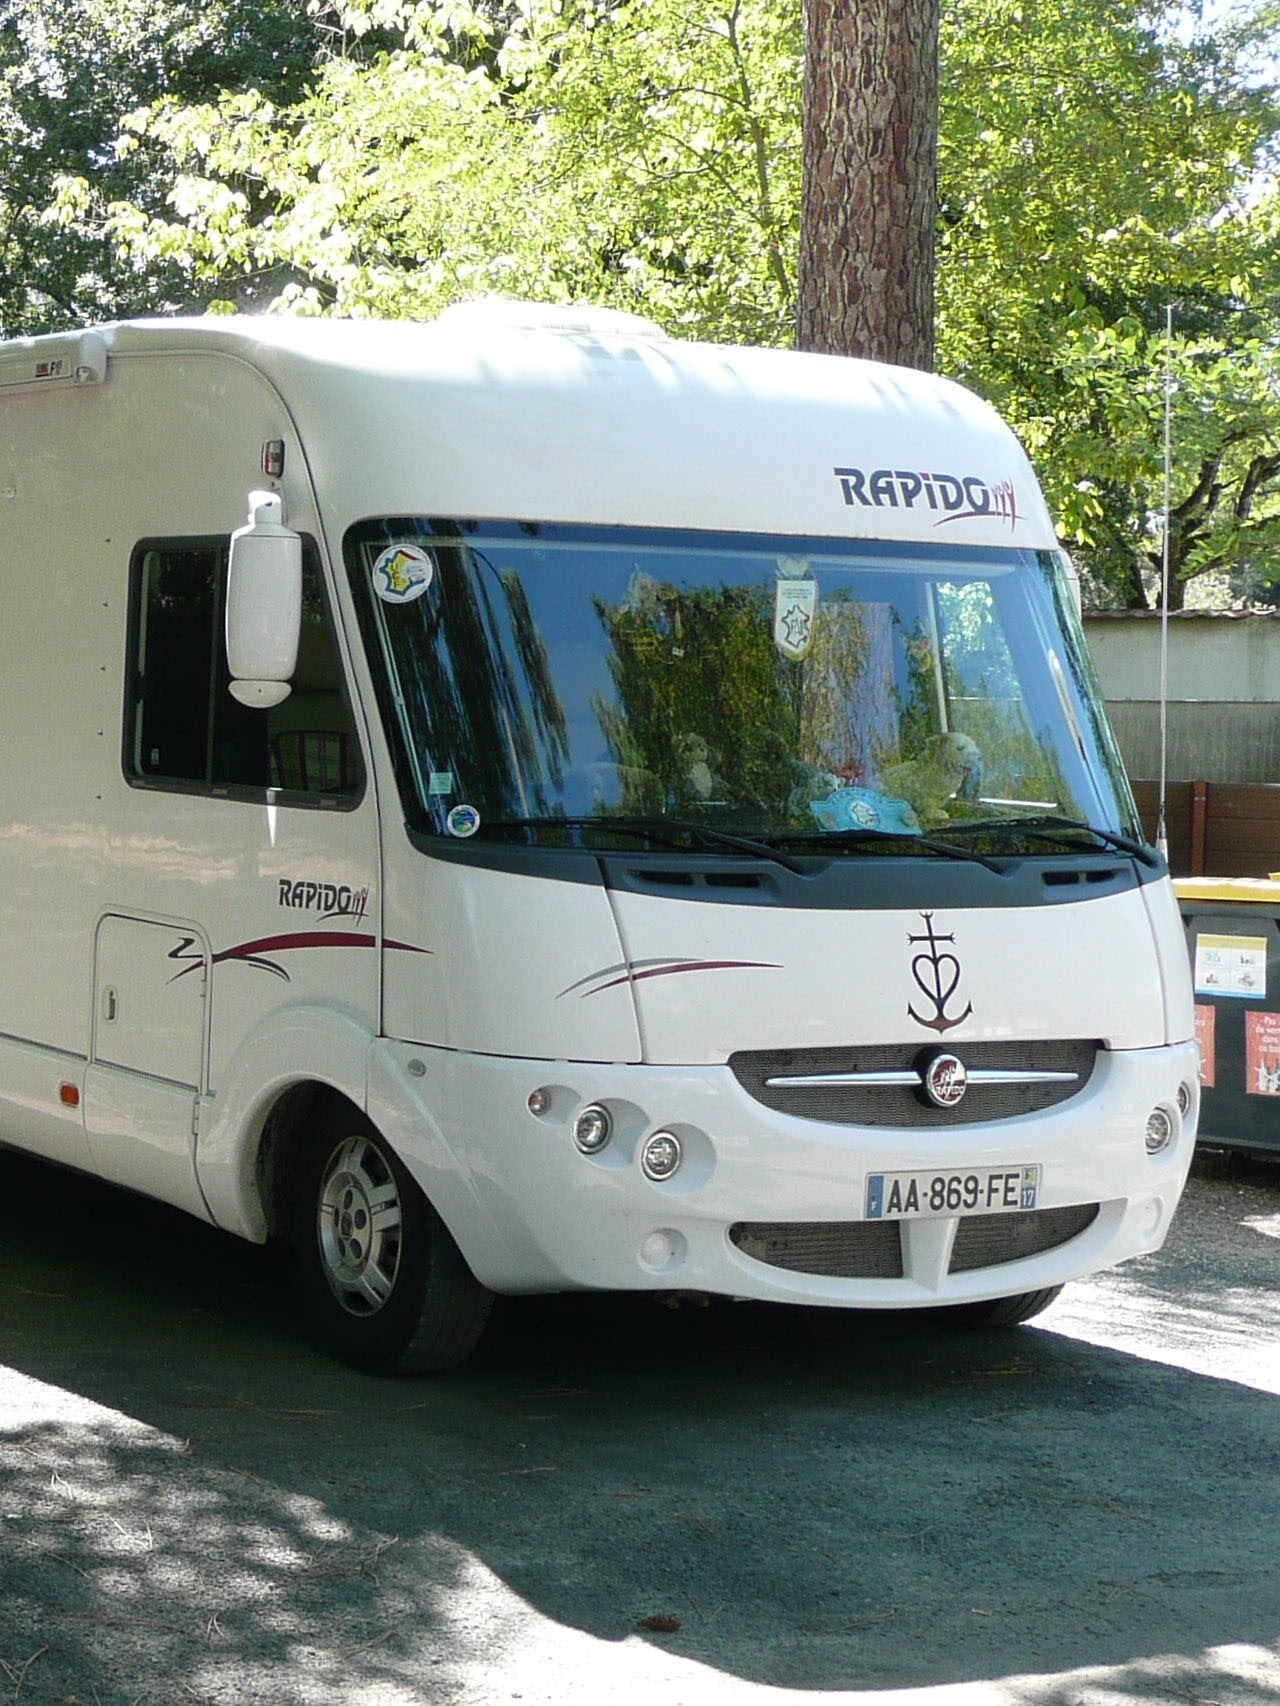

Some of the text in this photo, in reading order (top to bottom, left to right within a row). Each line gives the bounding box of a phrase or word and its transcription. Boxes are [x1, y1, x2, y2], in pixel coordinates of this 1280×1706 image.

[886, 1172, 1020, 1214] AA-869-FE
[1023, 1189, 1035, 1206] 17
[871, 1201, 878, 1211] F
